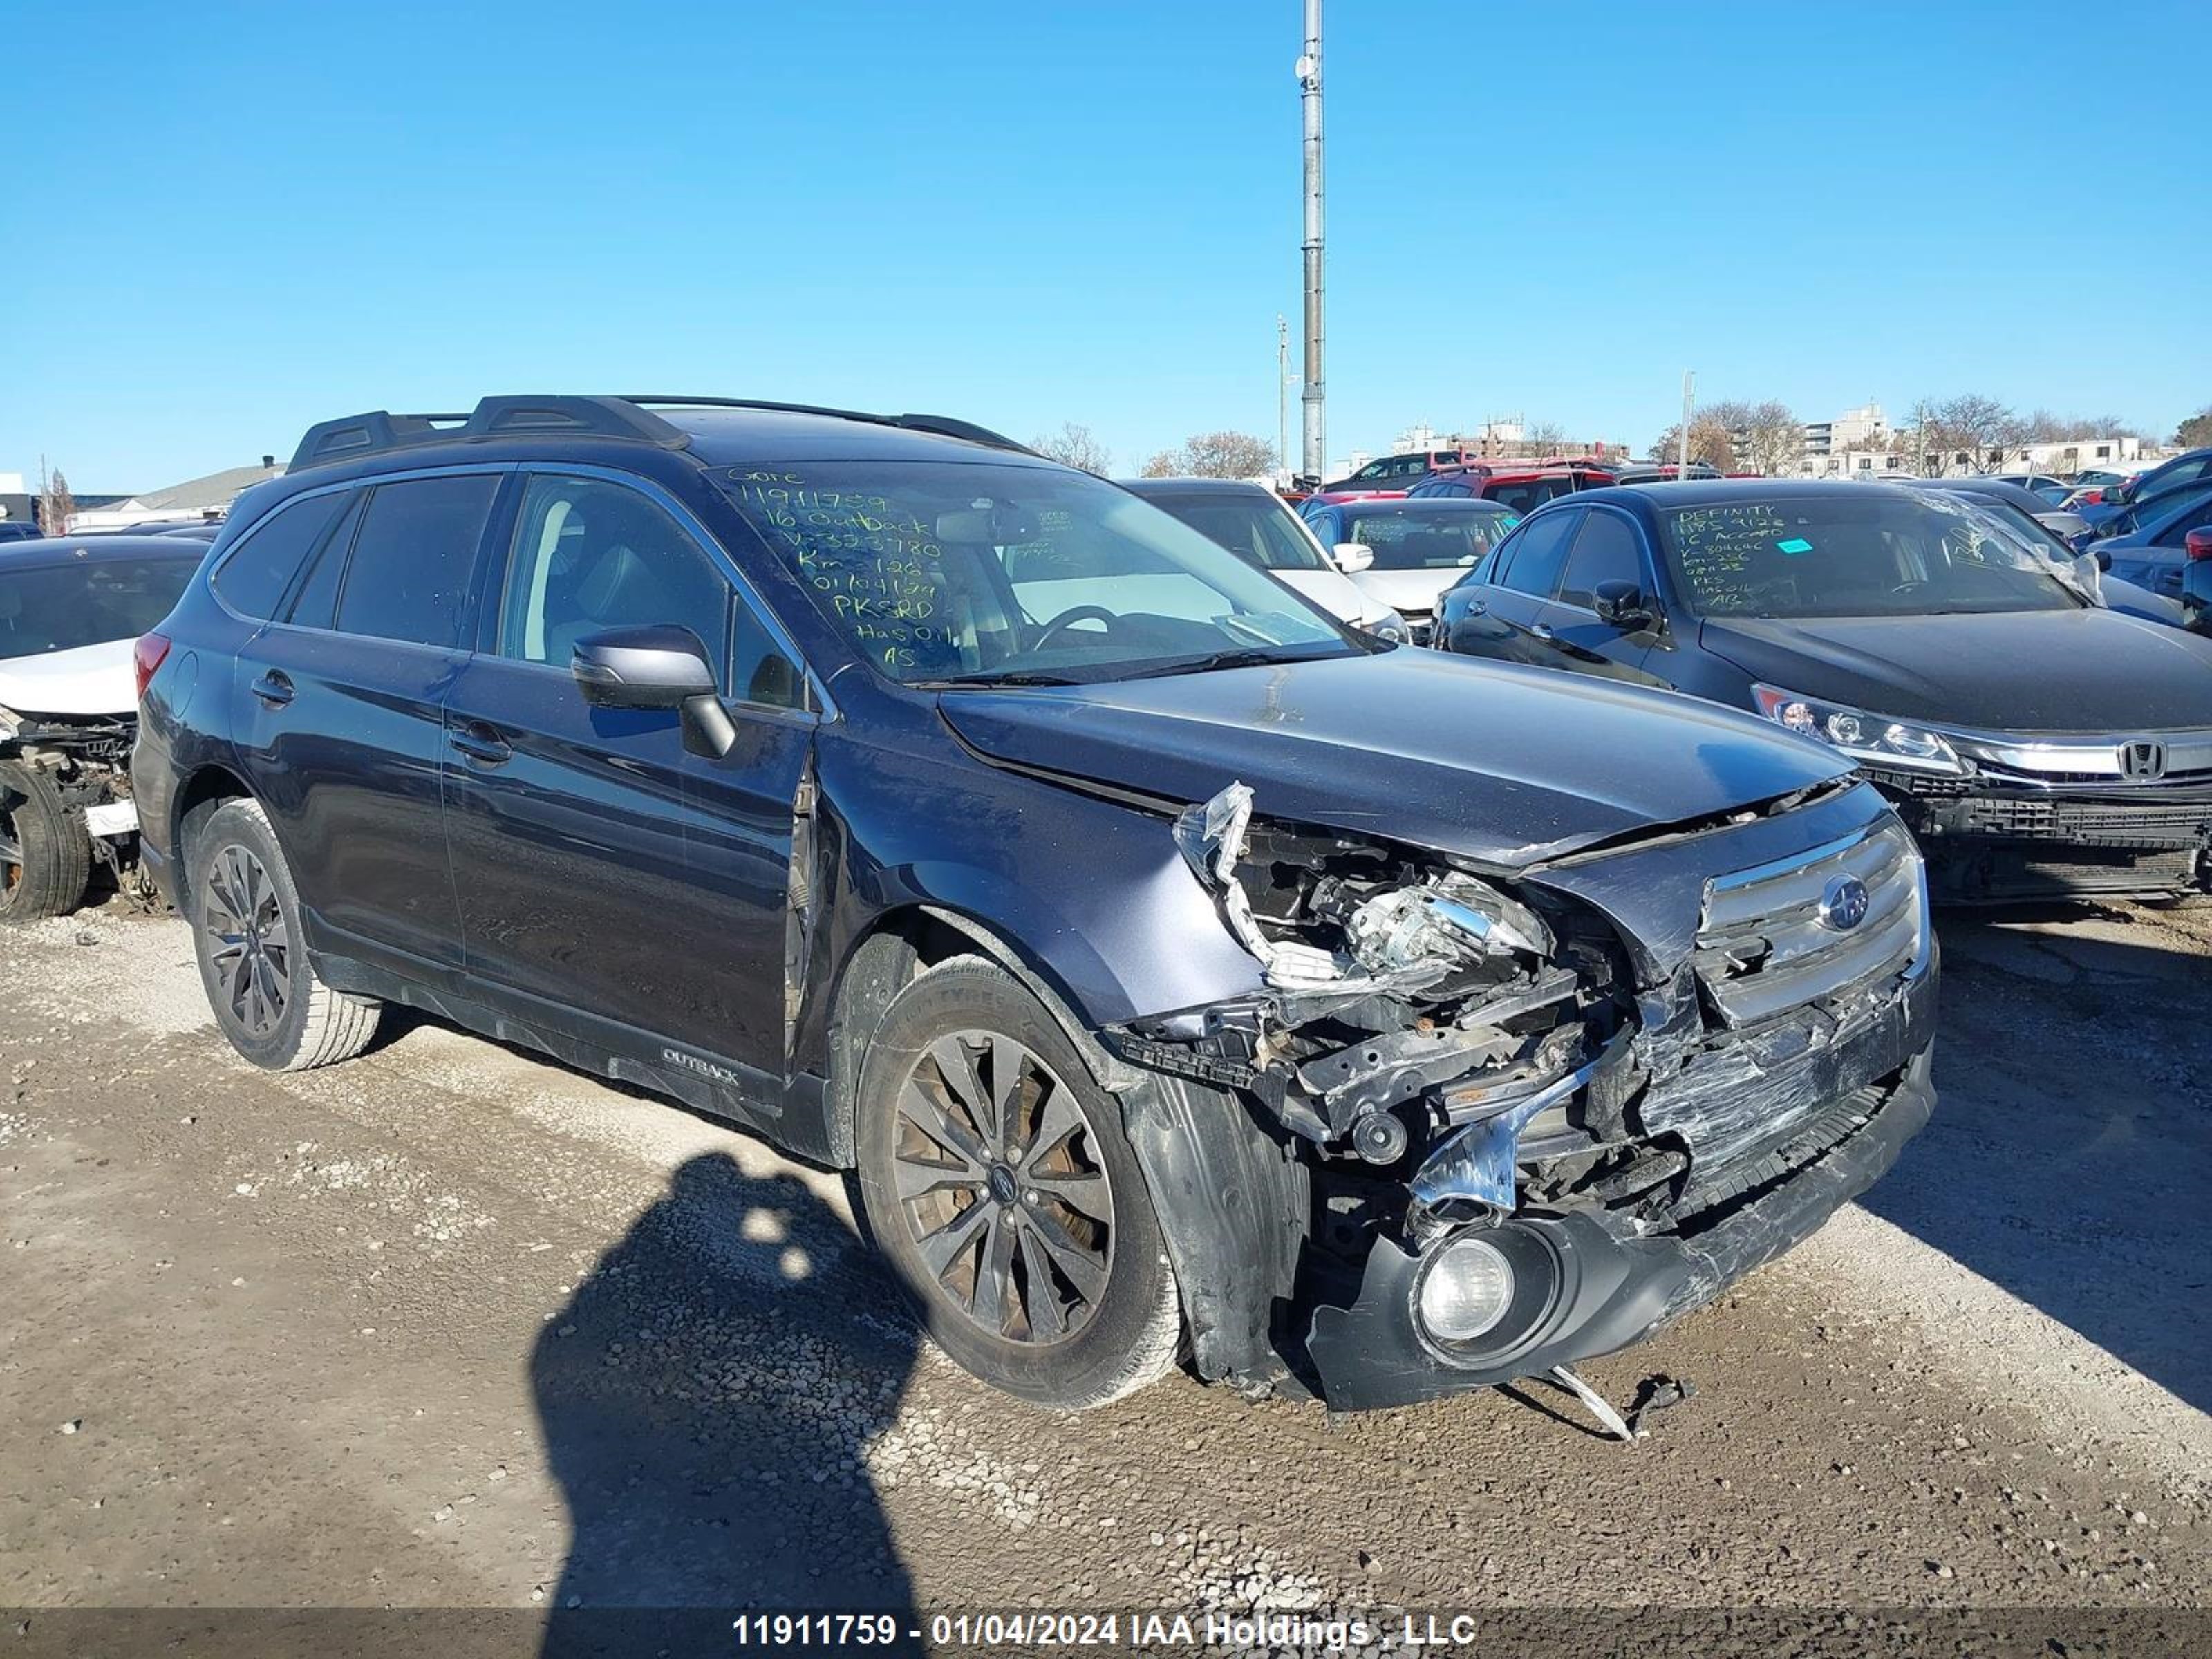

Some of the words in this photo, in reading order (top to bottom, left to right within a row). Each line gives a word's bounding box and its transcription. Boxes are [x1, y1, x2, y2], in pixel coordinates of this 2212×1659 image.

[742, 485, 886, 512] 11911759
[767, 509, 795, 527] 16
[808, 511, 928, 534] Outback
[1680, 505, 1775, 523] DEFINITY
[662, 1048, 740, 1087] OUTBACK
